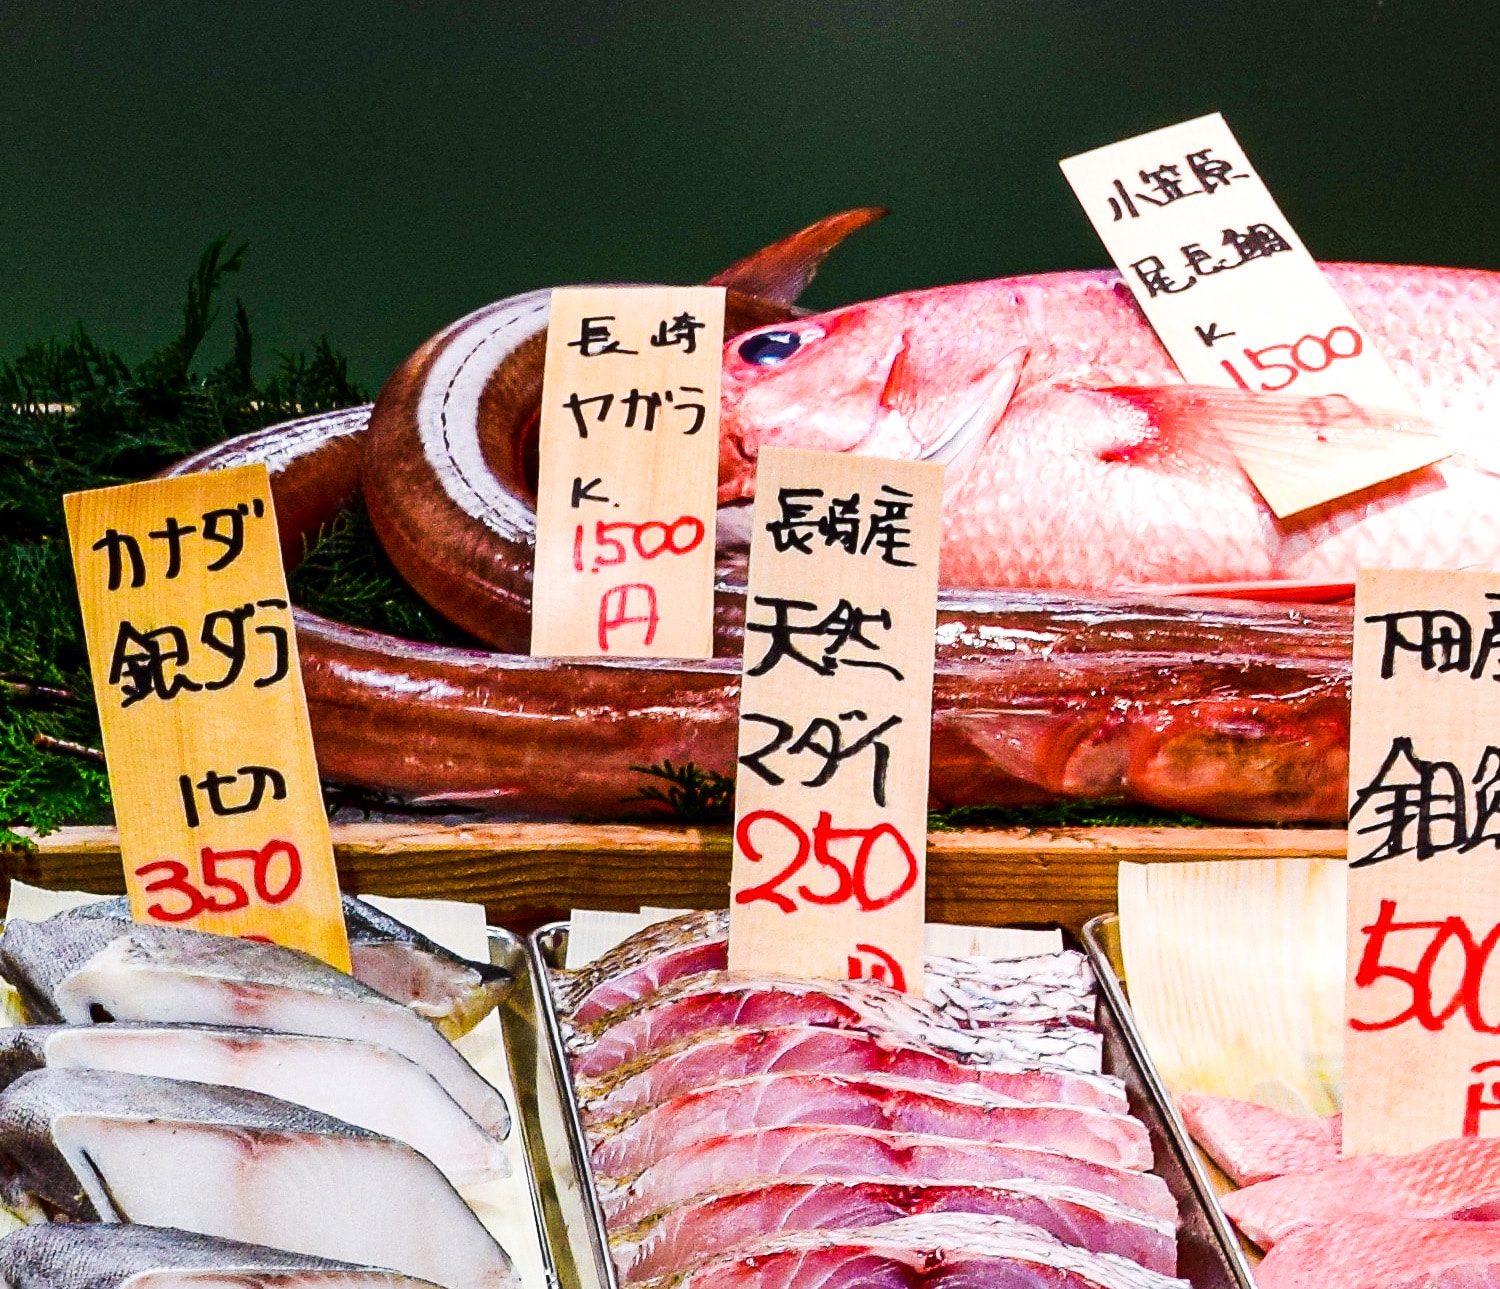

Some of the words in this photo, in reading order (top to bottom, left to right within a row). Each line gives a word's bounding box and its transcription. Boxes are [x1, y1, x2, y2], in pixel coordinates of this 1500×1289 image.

[567, 311, 706, 356] 長崎
[1221, 326, 1362, 392] 1500
[93, 499, 264, 591] カナダ
[766, 485, 918, 568] 長崎産
[108, 598, 289, 708] 銀ダラ
[598, 583, 661, 652] 円
[746, 596, 905, 680] 天然
[179, 765, 287, 828] 1切
[739, 711, 904, 807] マダイ
[135, 840, 301, 923] 350
[736, 809, 918, 913] 250
